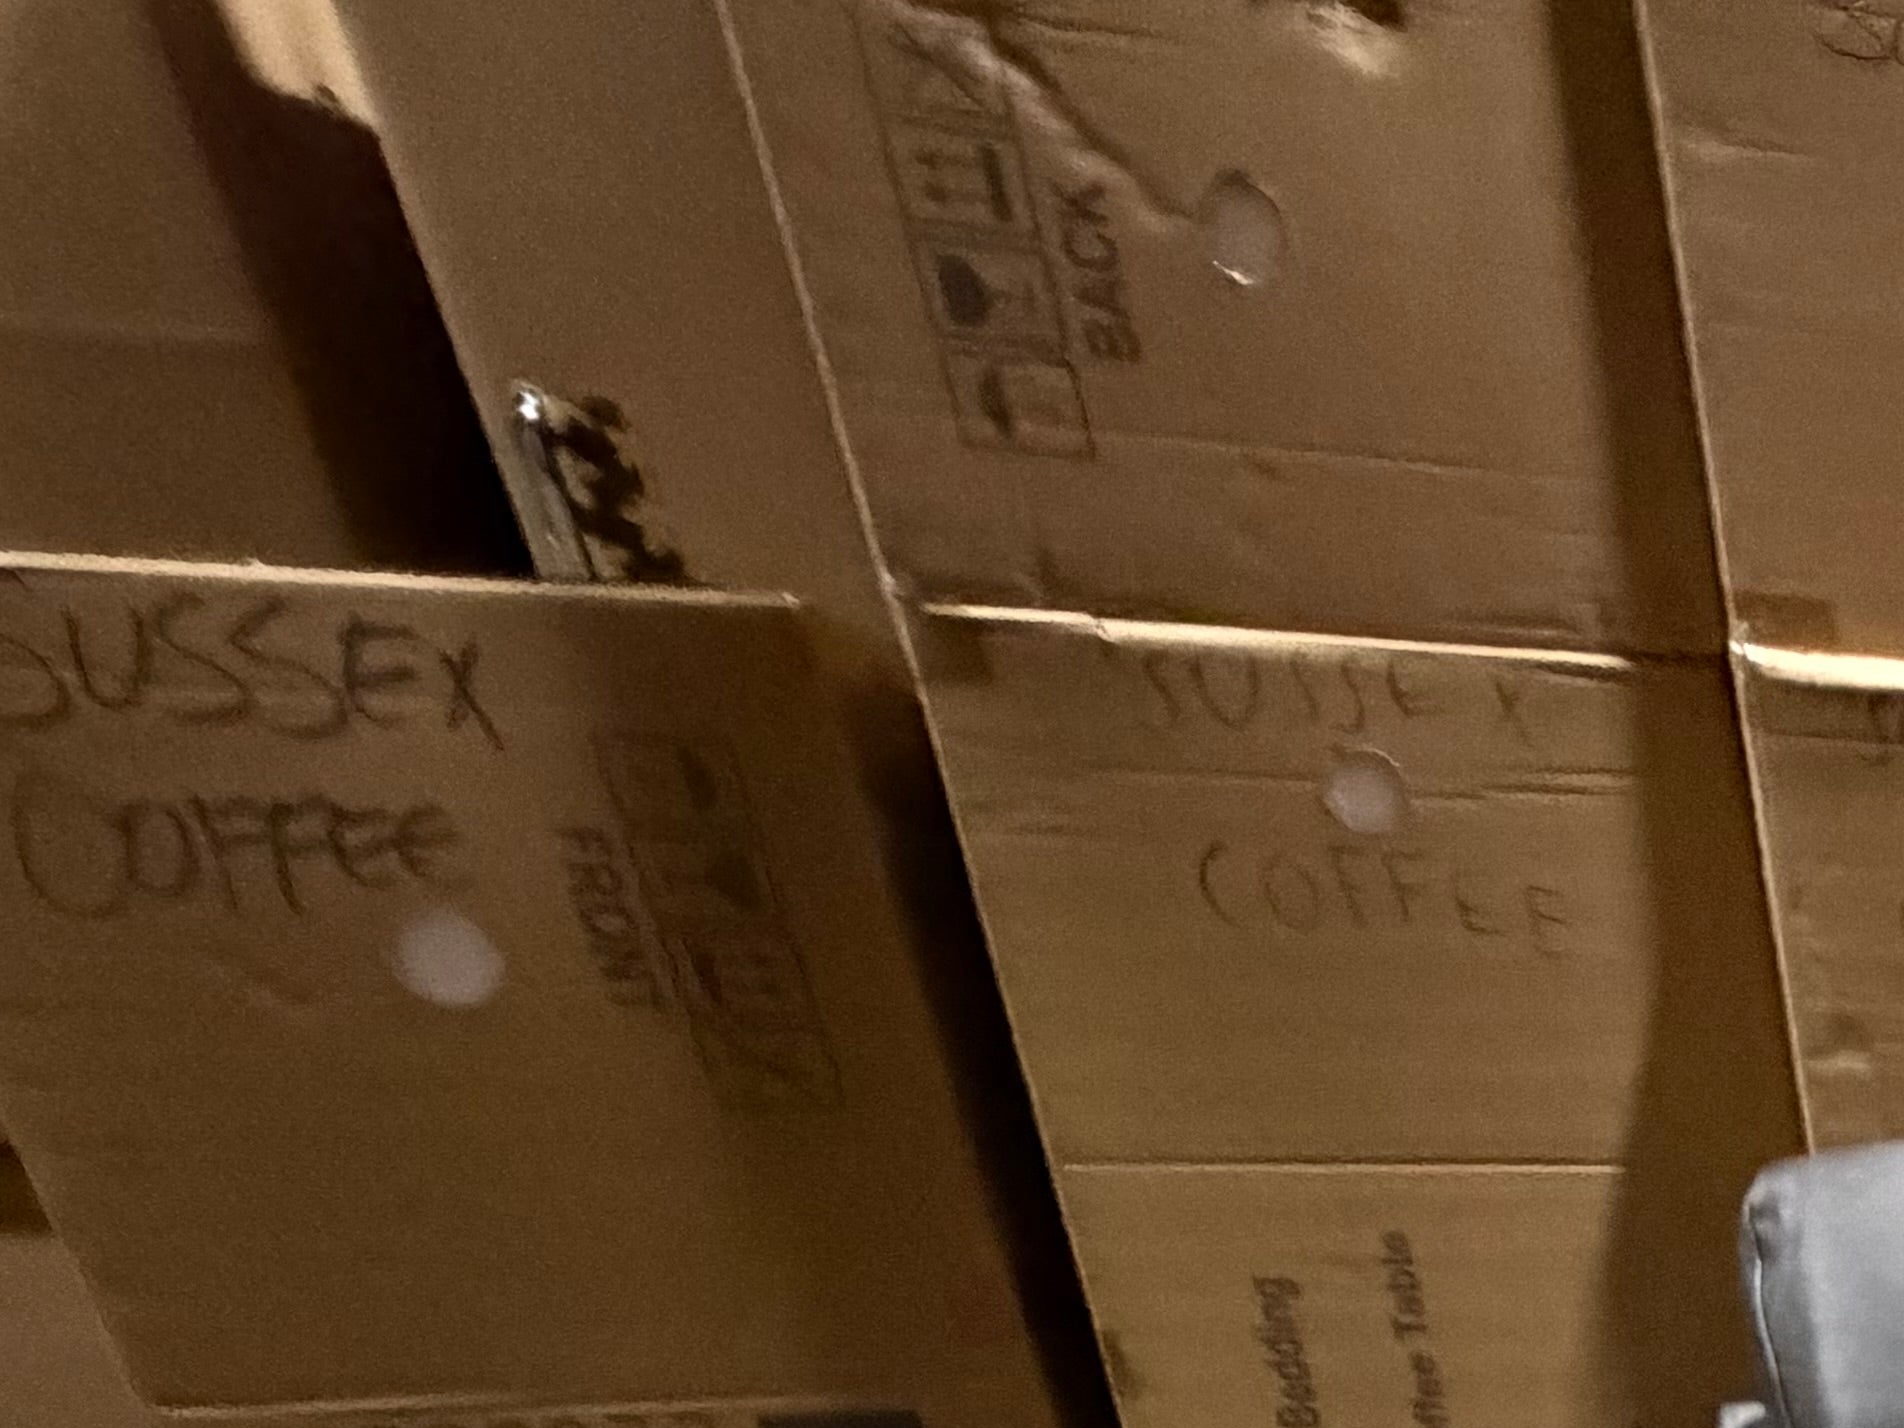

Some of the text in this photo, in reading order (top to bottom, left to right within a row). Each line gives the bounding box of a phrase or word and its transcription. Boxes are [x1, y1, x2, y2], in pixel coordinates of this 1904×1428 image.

[1056, 180, 1140, 362] BACK
[10, 793, 468, 922] COFFEE
[1254, 1277, 1319, 1428] Bedding
[1380, 1230, 1425, 1337] Table
